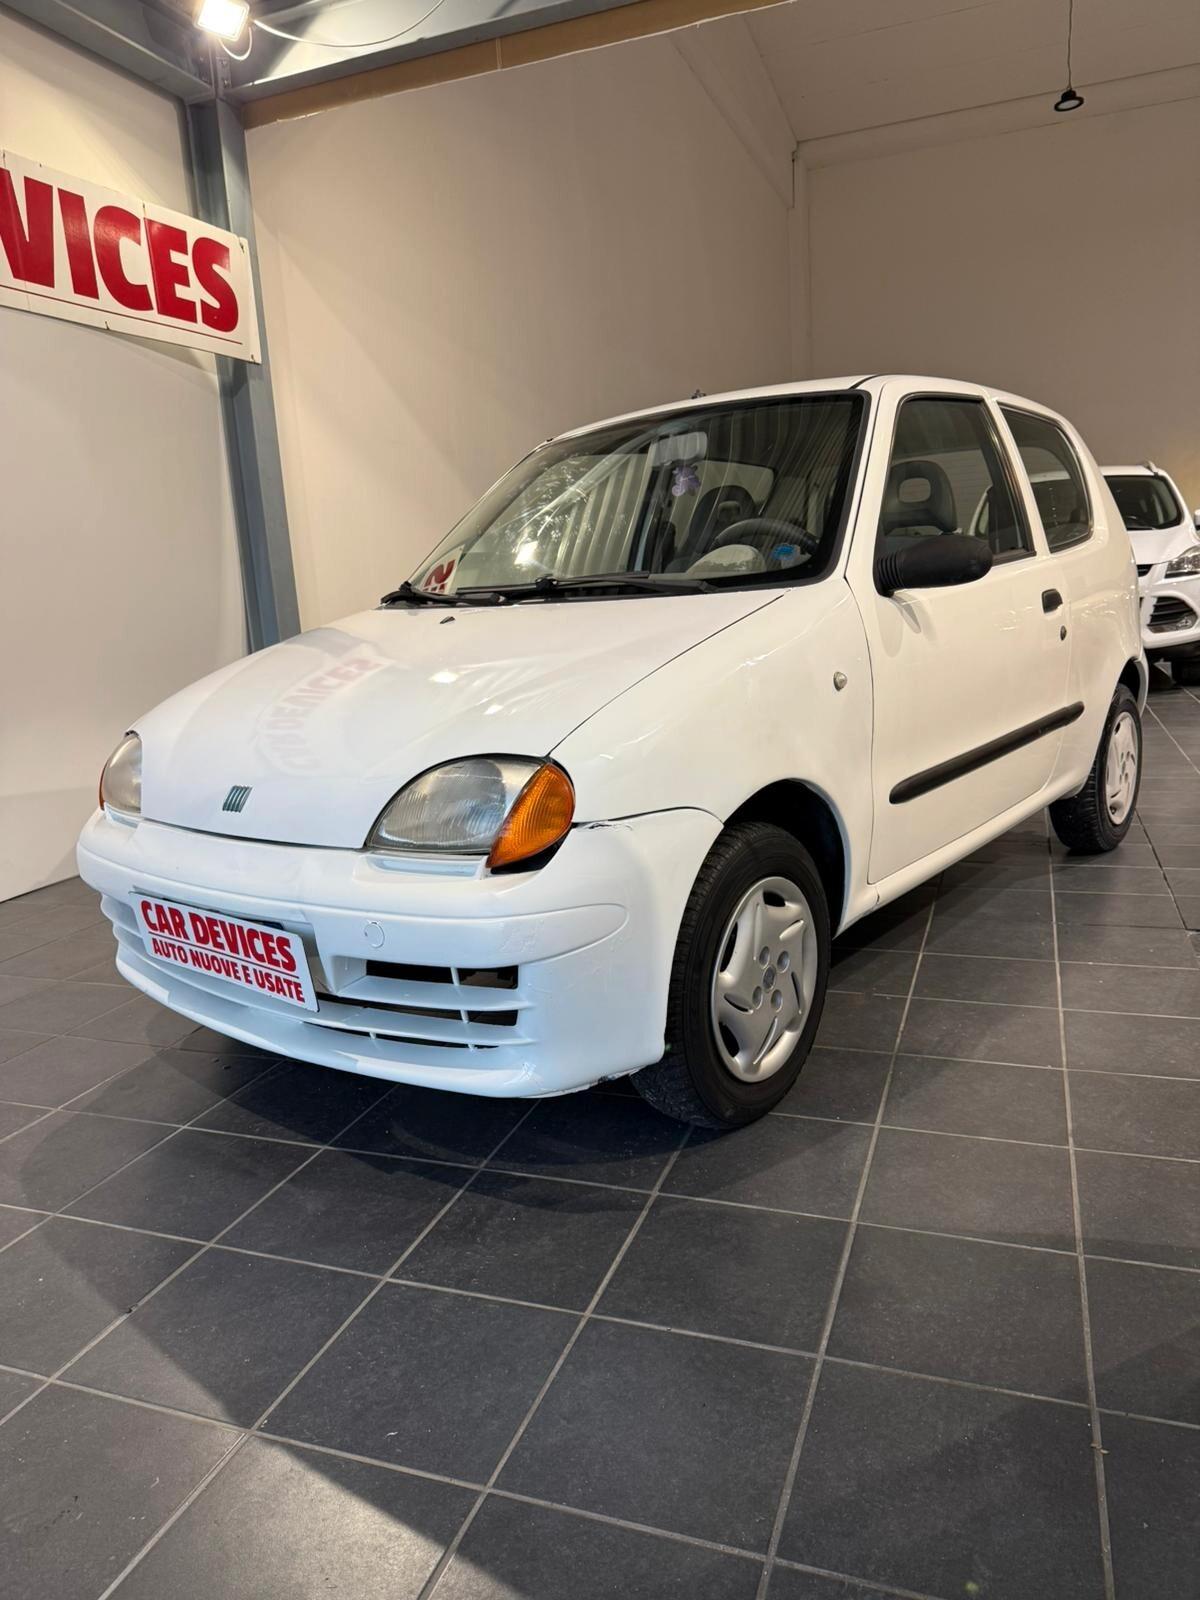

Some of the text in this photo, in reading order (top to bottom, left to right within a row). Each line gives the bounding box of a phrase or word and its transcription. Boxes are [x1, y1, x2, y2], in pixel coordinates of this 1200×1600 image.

[0, 166, 239, 333] VICES
[140, 900, 297, 973] CAR DEVICES
[151, 937, 305, 1003] AUTO NUOVE E USATE
